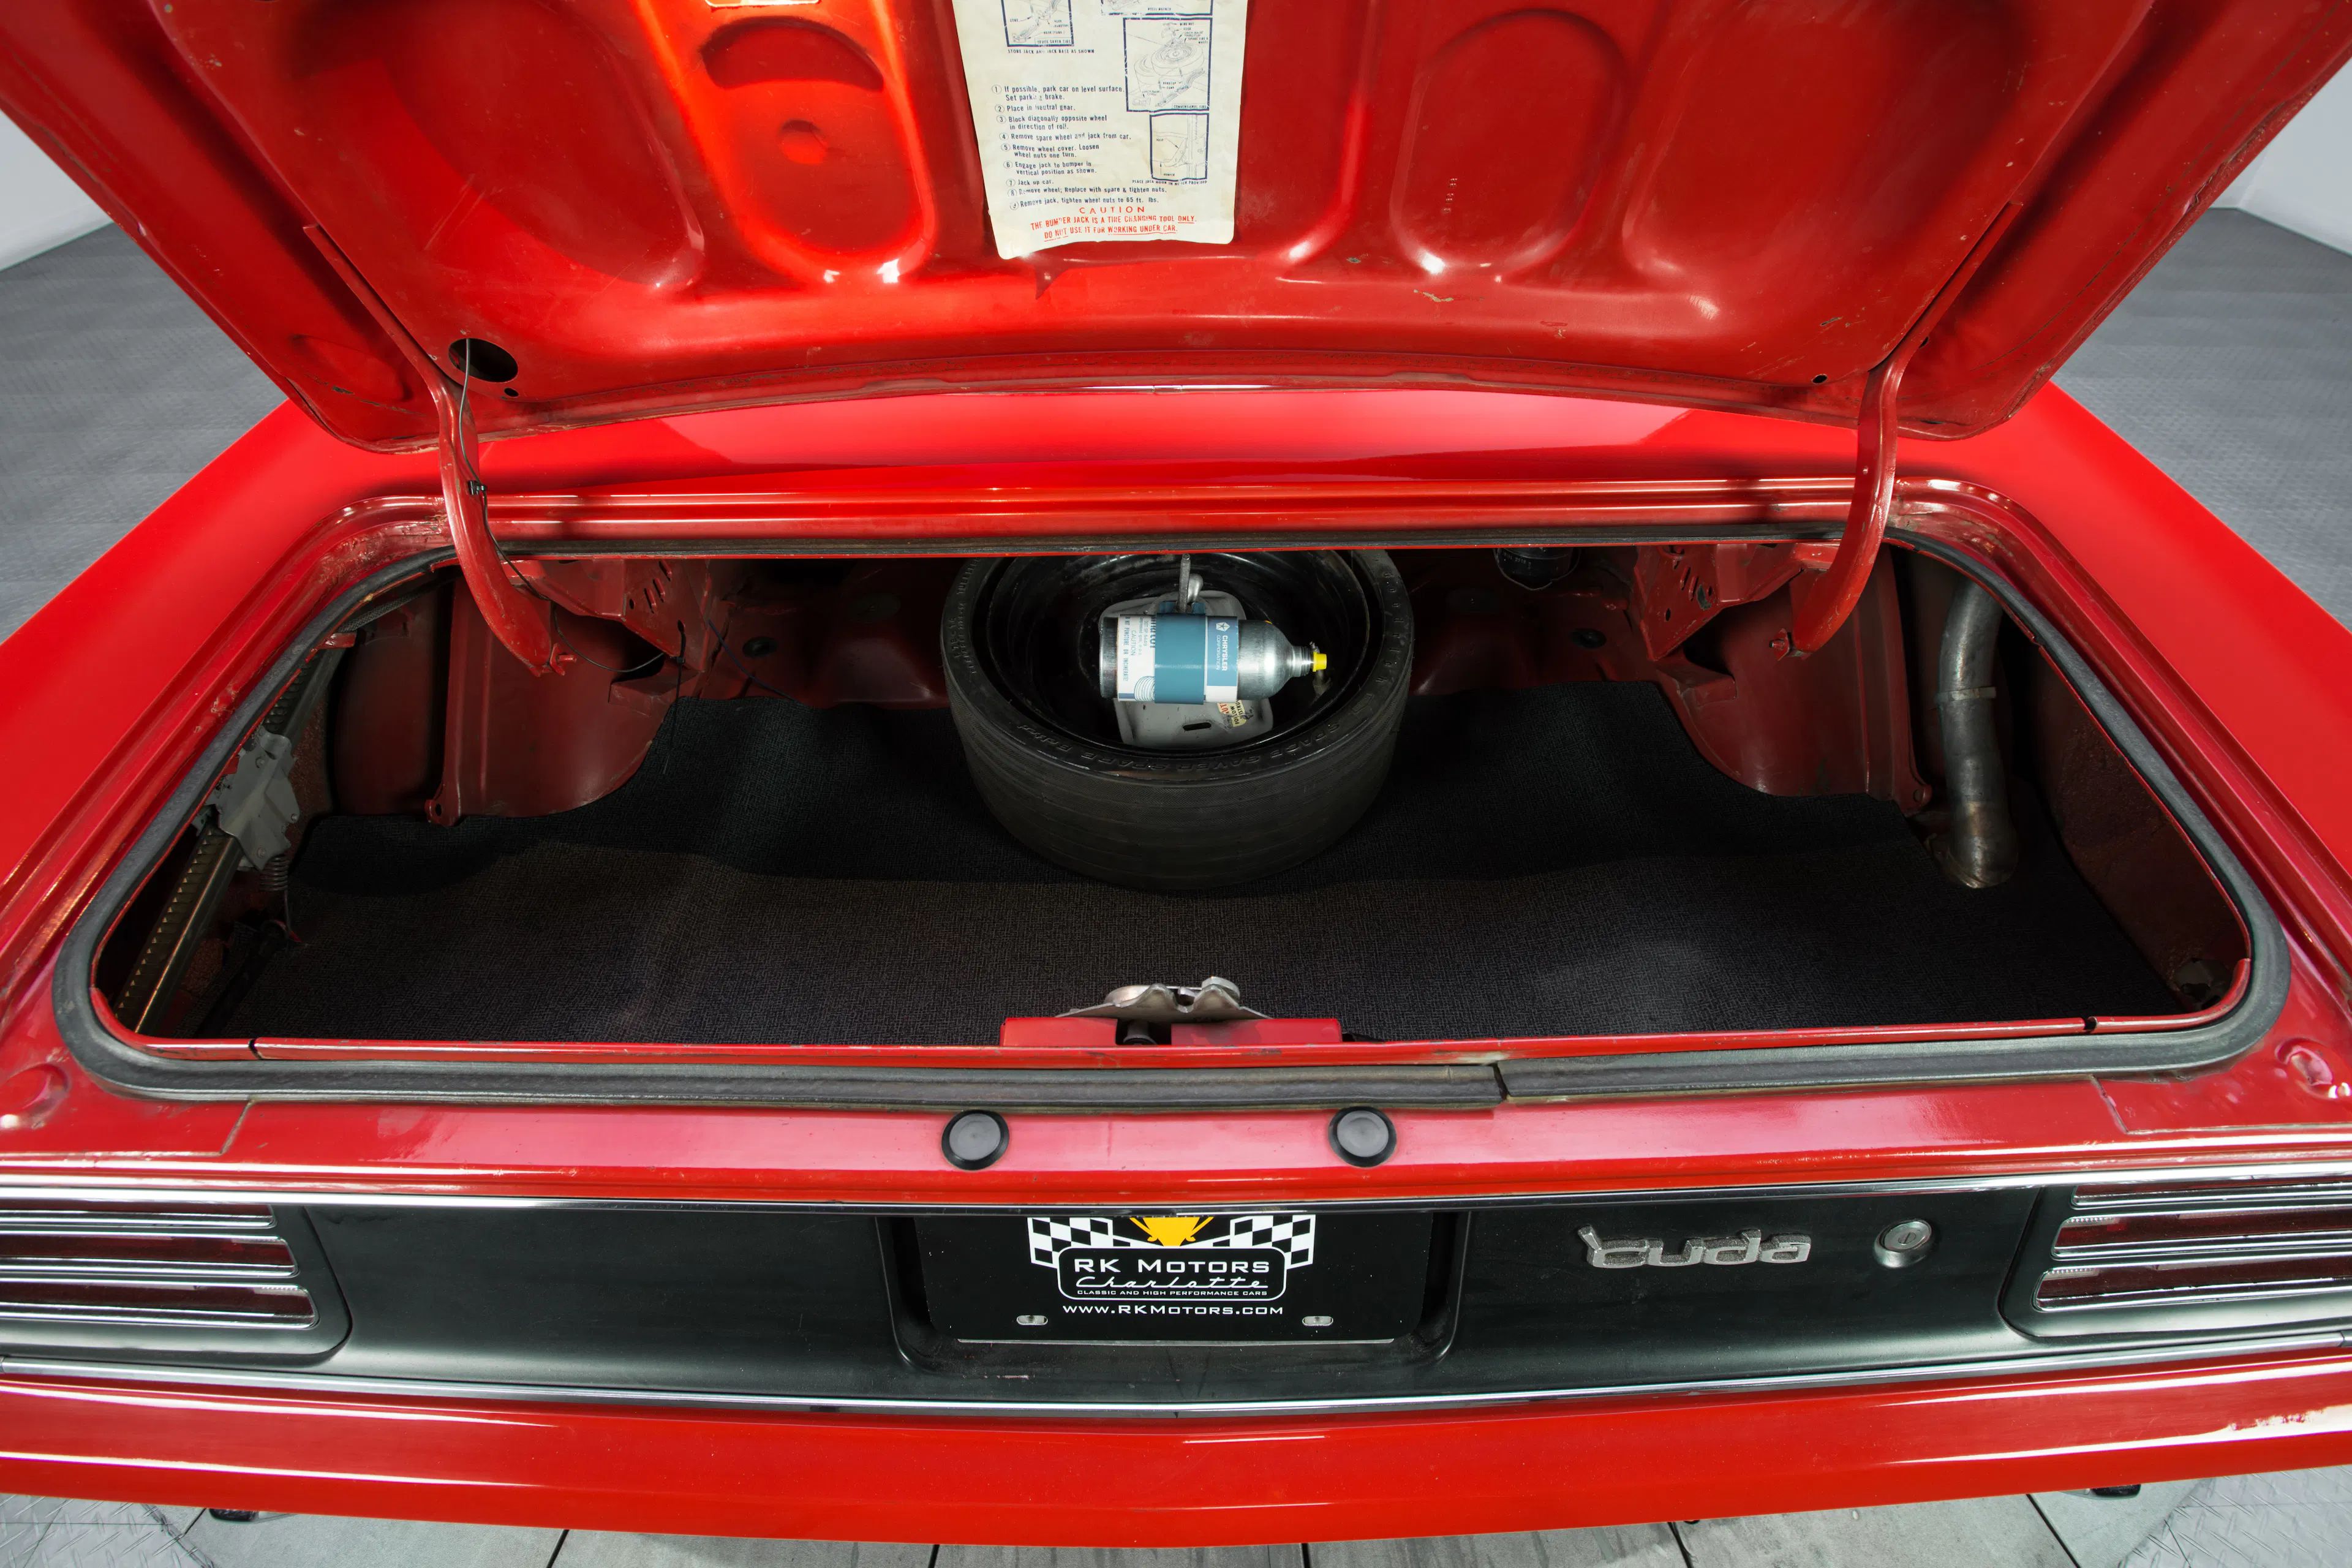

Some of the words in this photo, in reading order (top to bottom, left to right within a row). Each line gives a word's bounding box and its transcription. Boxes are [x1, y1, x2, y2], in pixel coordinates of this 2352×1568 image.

[1079, 206, 1145, 214] CAUTION
[1030, 221, 1042, 230] THE
[1270, 722, 1341, 759] SPACE
[1080, 752, 1169, 770] SPARE
[1177, 755, 1262, 771] SAVER
[1074, 1259, 1121, 1273] RK
[1137, 1259, 1269, 1273] MOTORS
[1076, 1276, 1268, 1289] Charlotte
